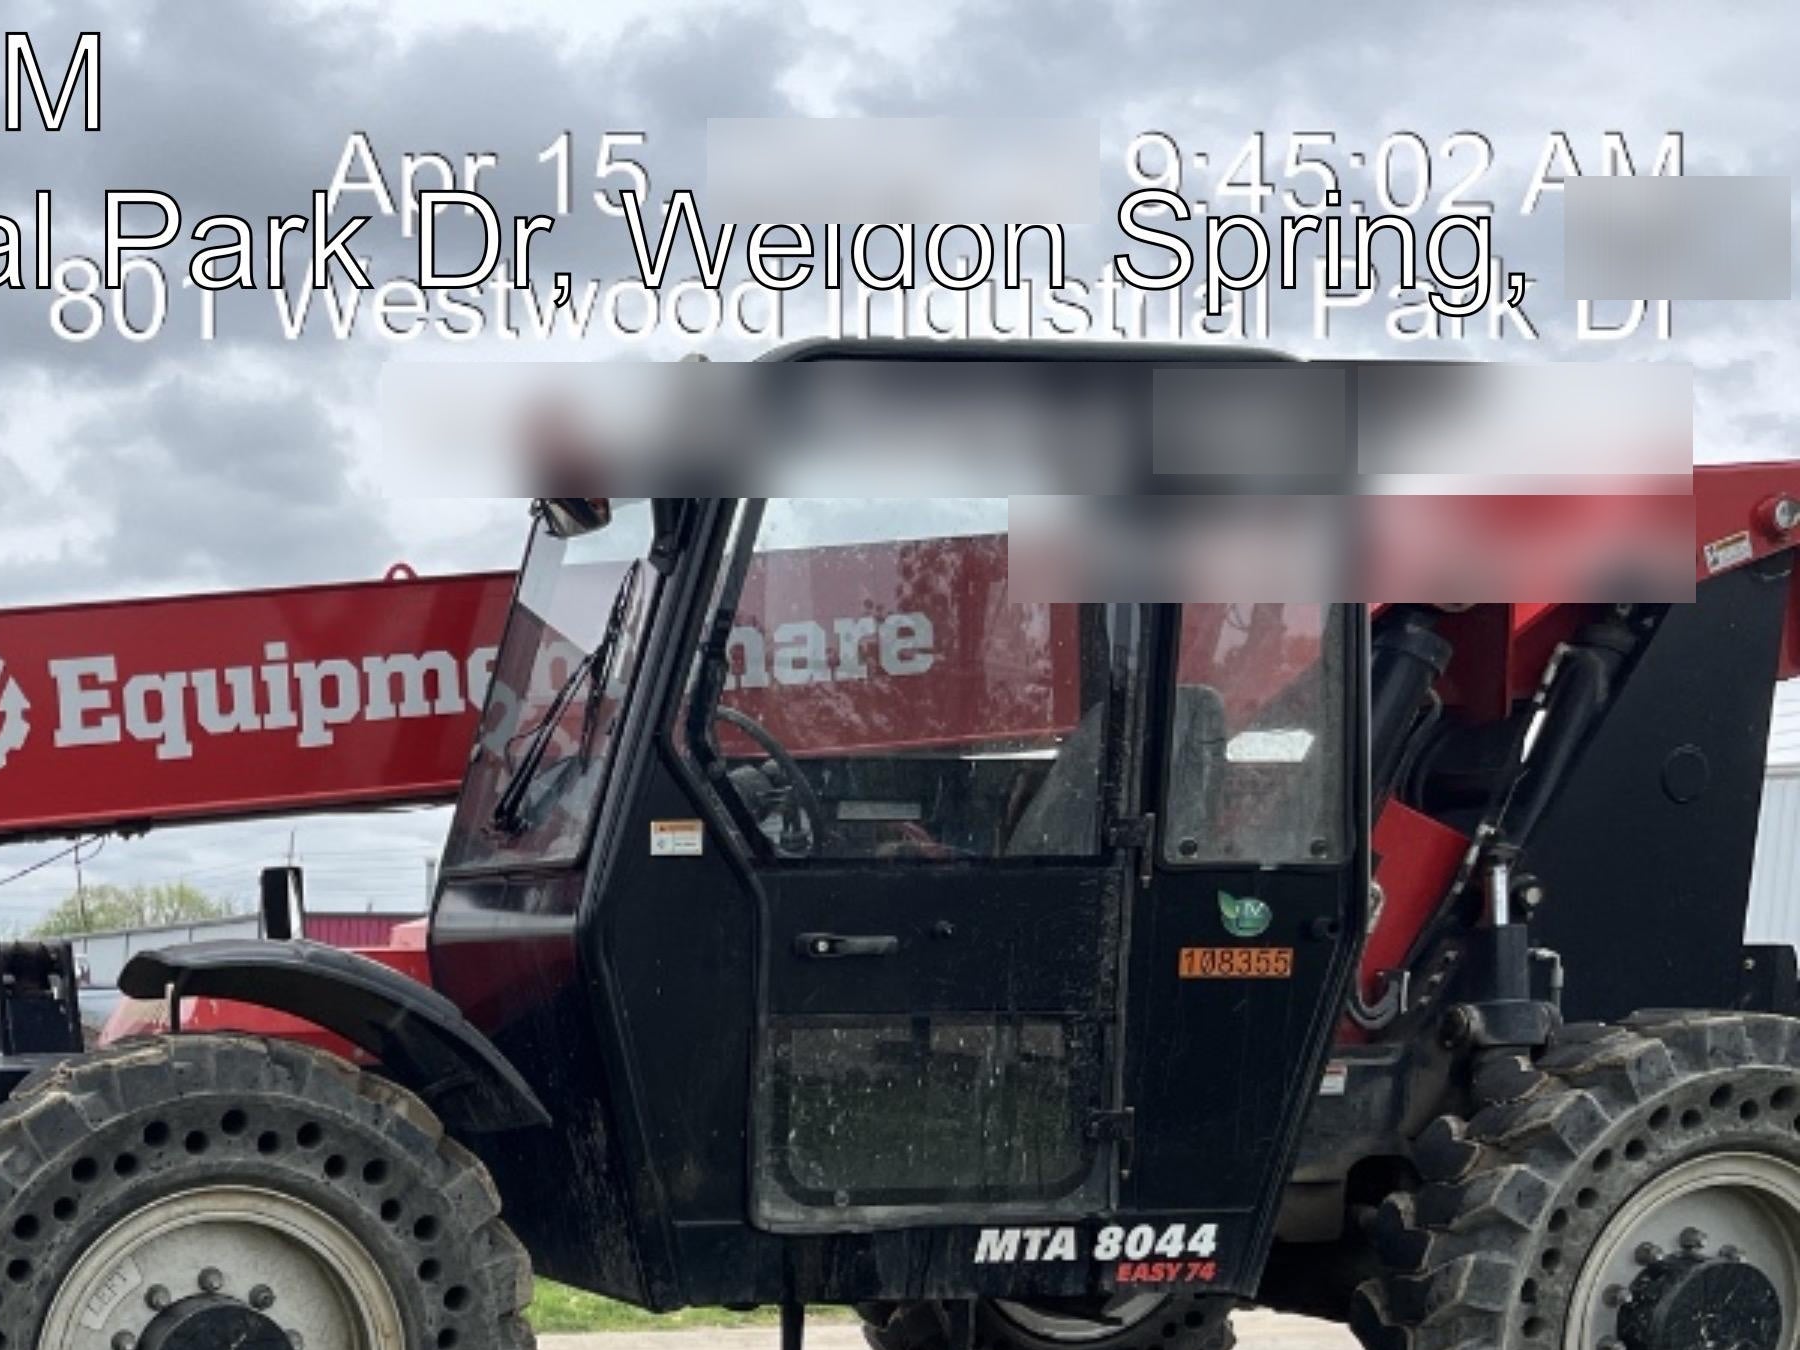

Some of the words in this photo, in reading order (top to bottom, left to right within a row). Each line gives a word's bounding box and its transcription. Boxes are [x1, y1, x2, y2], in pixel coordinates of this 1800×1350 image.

[1182, 949, 1290, 975] 108355
[974, 1226, 1077, 1264] MTA
[1094, 1223, 1218, 1261] 8044
[1116, 1262, 1180, 1282] EASY
[1184, 1262, 1216, 1282] 74
